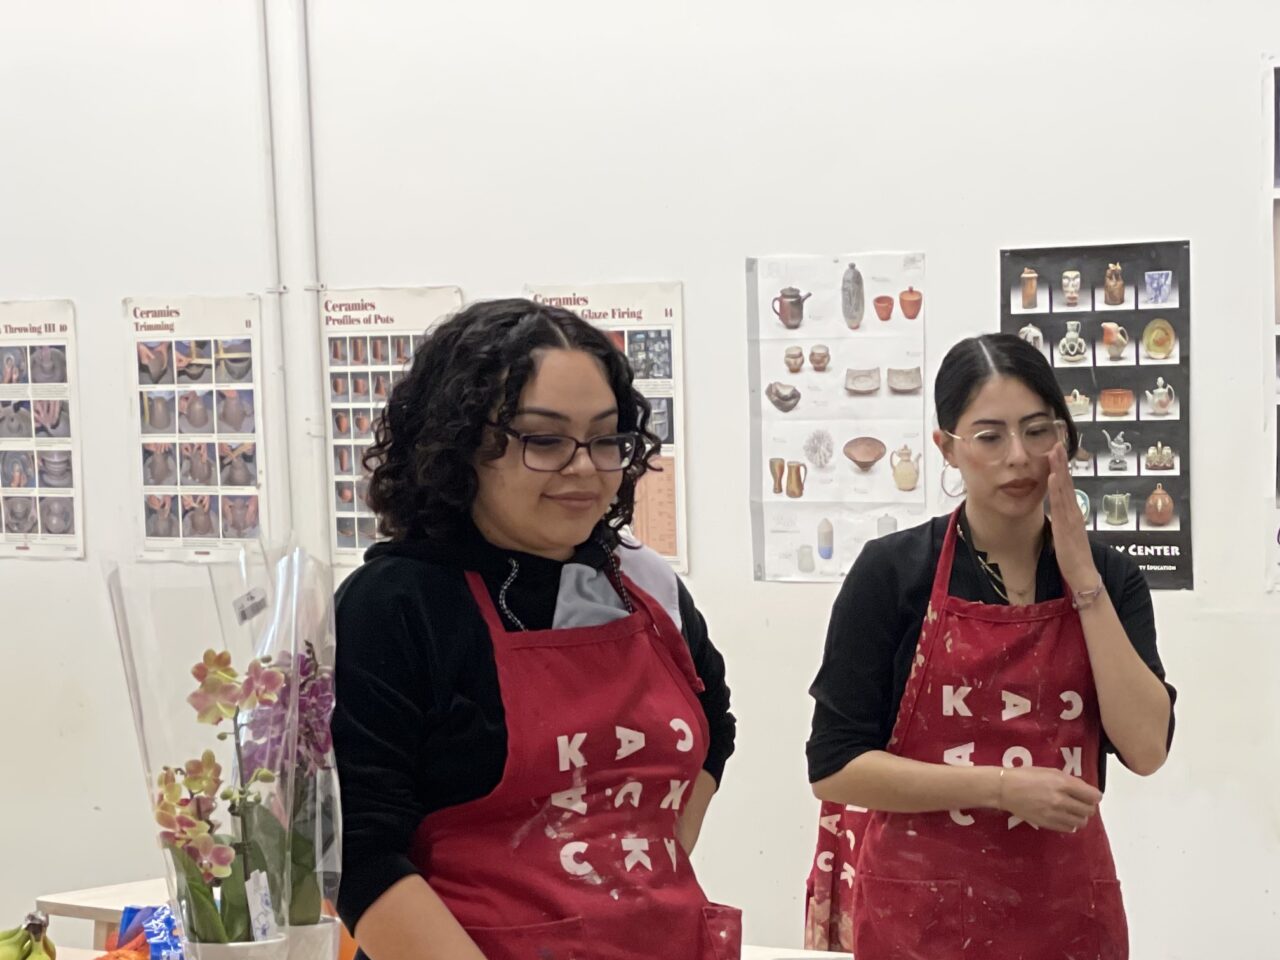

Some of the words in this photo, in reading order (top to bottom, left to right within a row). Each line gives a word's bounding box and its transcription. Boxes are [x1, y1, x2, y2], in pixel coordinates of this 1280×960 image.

[133, 305, 180, 318] Ceramics
[324, 298, 376, 312] Ceramics
[325, 315, 361, 325] Profiles
[363, 314, 372, 324] of
[374, 313, 395, 324] Pots
[581, 309, 609, 320] Glaze
[612, 307, 643, 320] Firing
[4, 323, 42, 335] Throwing
[134, 321, 175, 332] Trimming
[1128, 543, 1181, 557] CENTER
